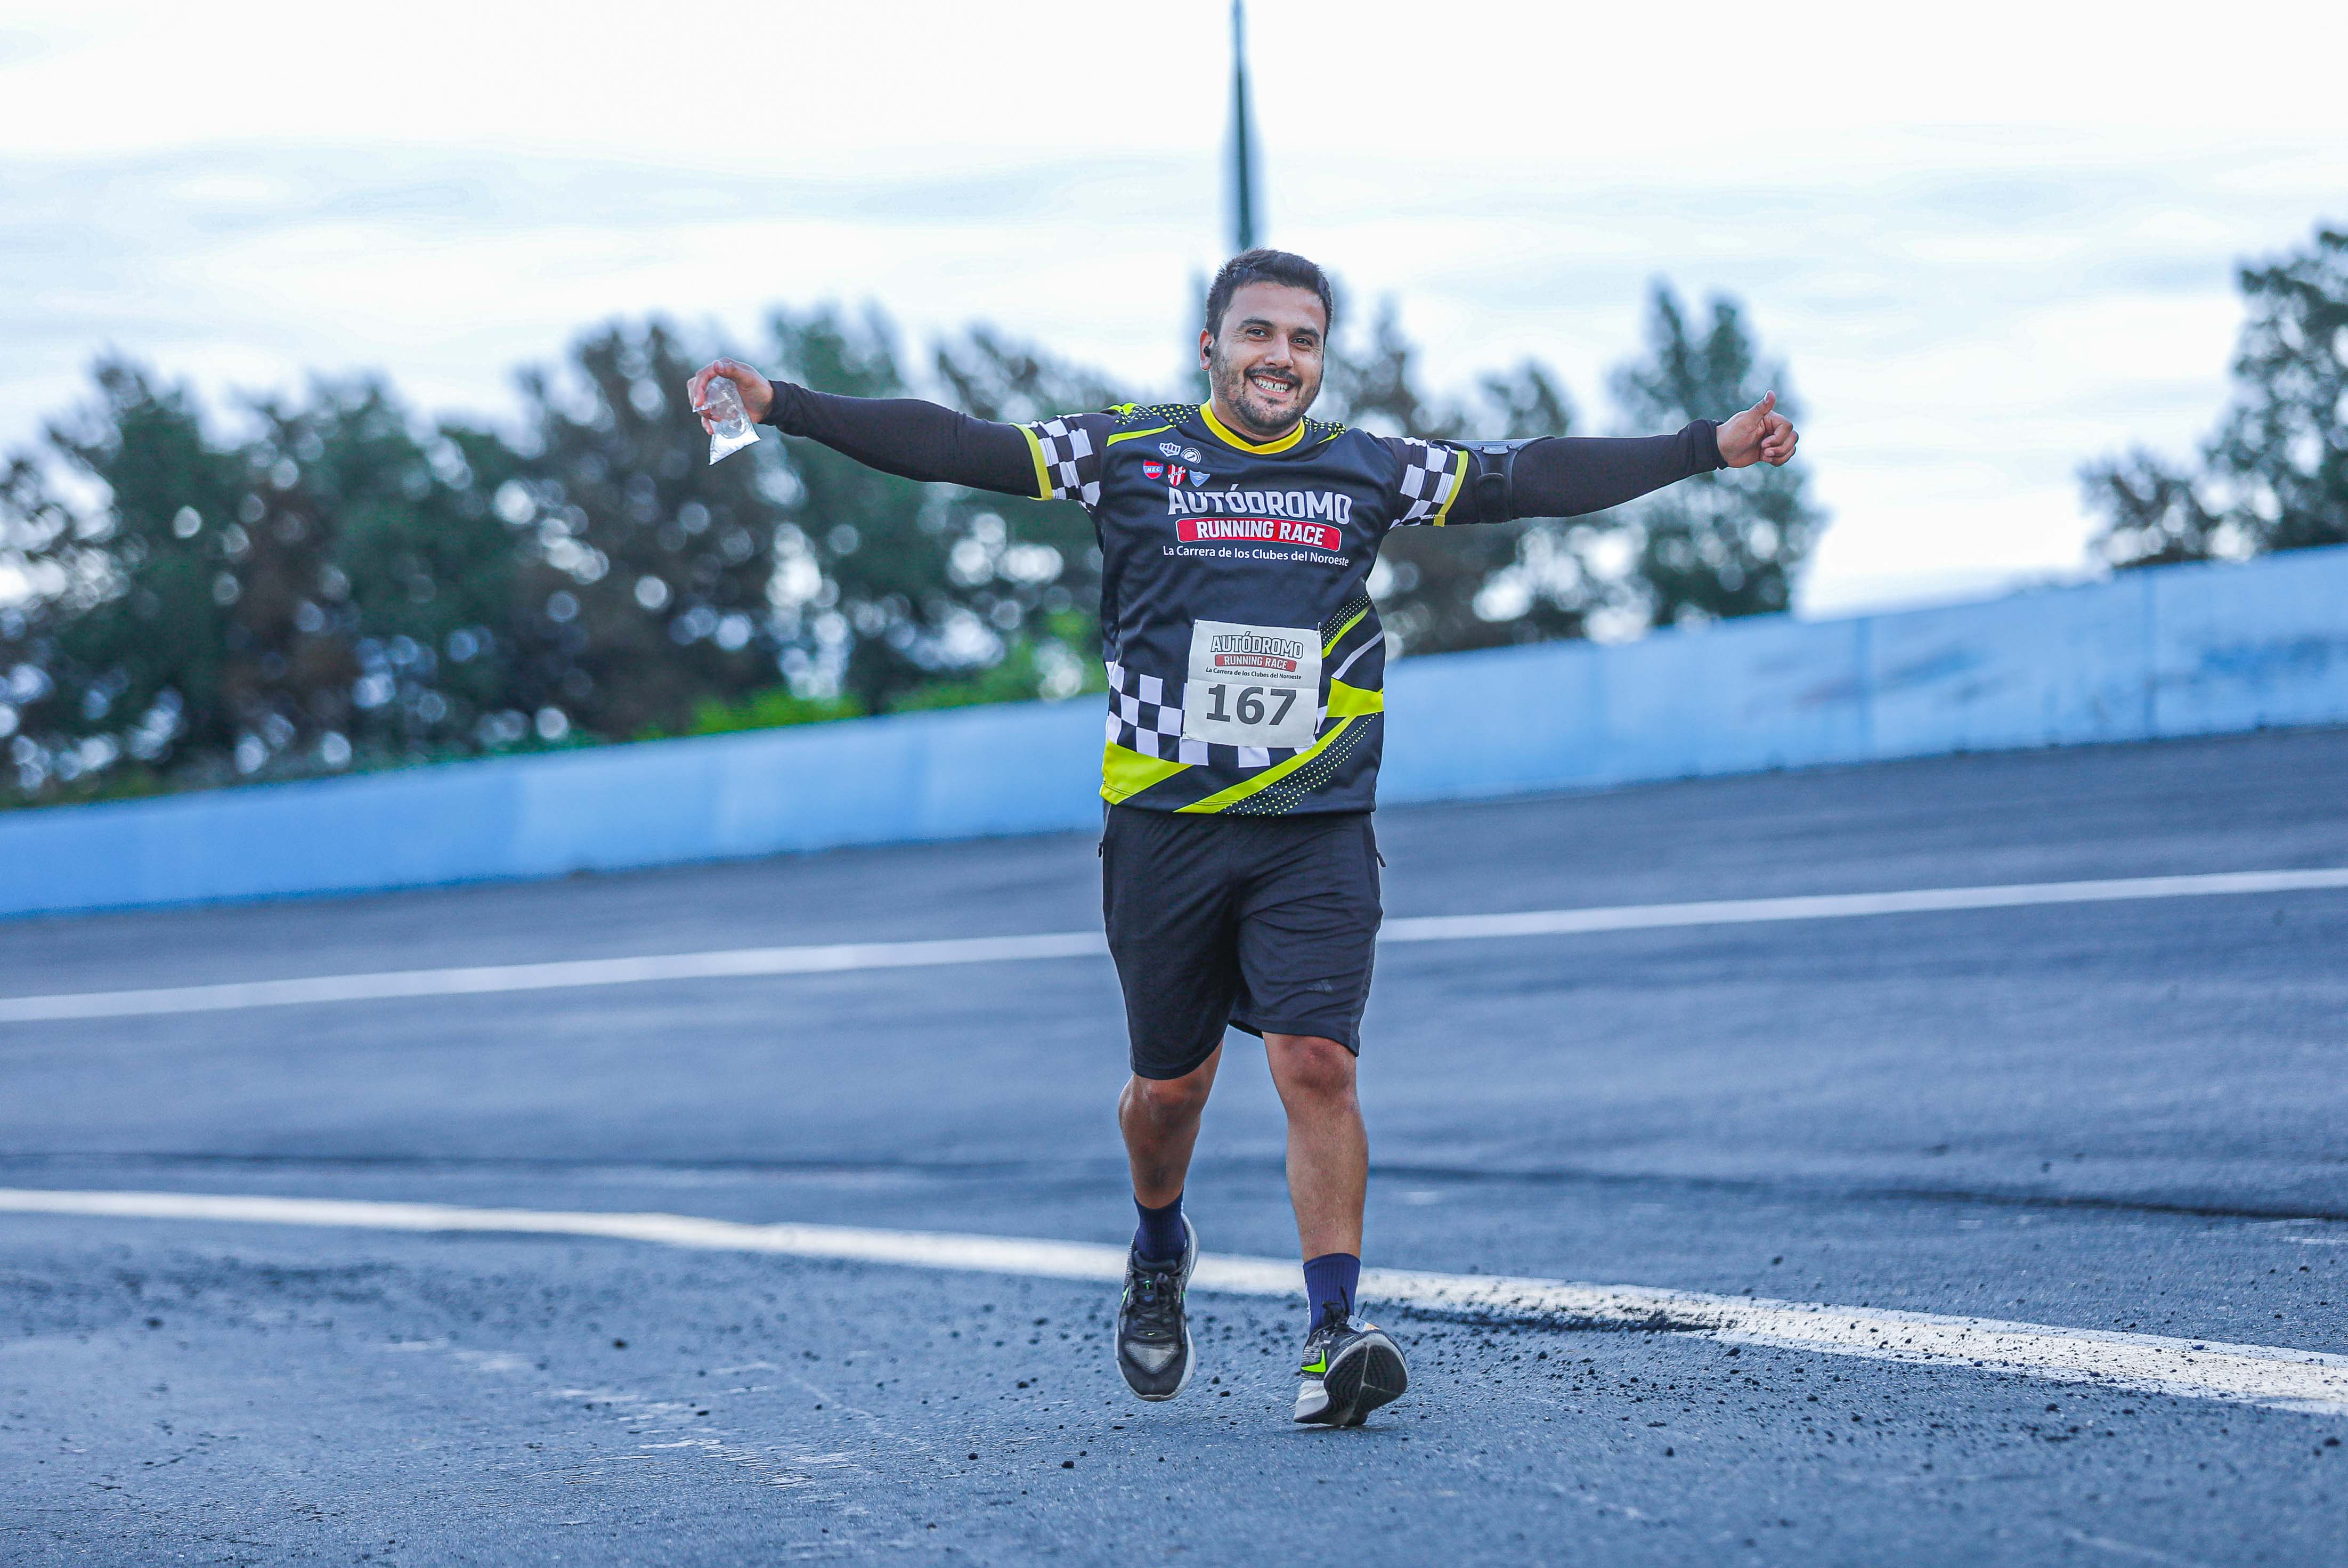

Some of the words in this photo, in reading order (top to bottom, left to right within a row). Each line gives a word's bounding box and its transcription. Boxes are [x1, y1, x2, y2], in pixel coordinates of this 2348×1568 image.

[1167, 484, 1352, 525] AUTÓDROMO
[1196, 520, 1274, 539] RUNNING
[1279, 522, 1325, 546] RACE
[1163, 546, 1174, 556] La
[1176, 546, 1216, 557] Carrera
[1218, 547, 1232, 558] de
[1234, 548, 1250, 558] los
[1252, 549, 1288, 560] Clubes
[1291, 551, 1307, 562] del
[1310, 552, 1349, 566] Noroeste
[1210, 631, 1304, 659] AUTÓDROMO
[1224, 656, 1263, 665] RUNNING
[1265, 659, 1288, 670] RACE
[1206, 684, 1296, 726] 167
